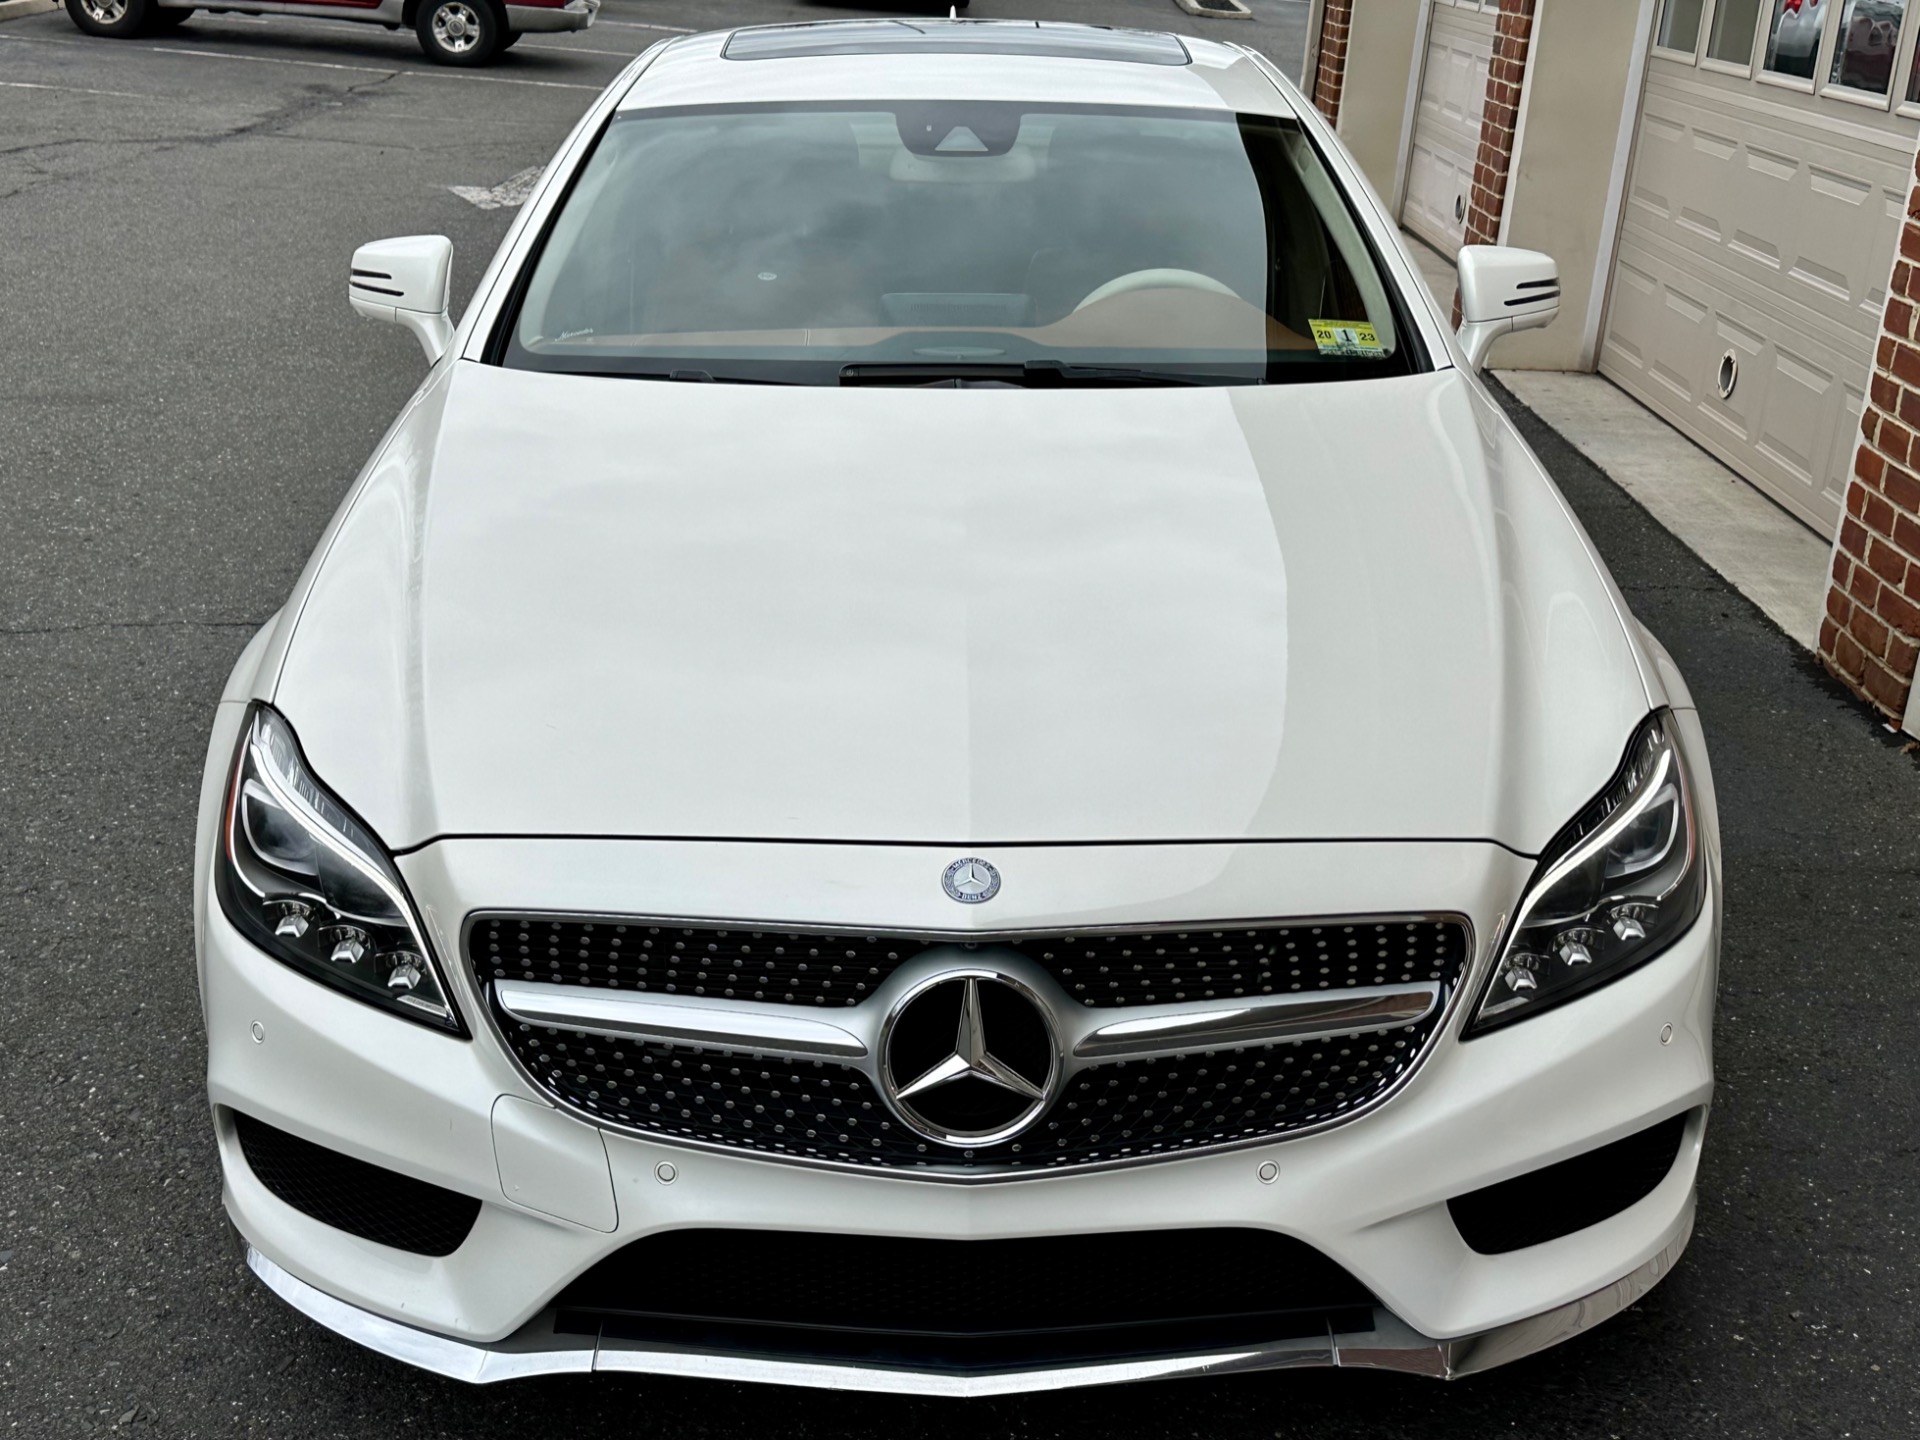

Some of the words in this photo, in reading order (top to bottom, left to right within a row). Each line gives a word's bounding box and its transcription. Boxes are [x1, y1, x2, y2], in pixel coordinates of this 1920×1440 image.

[1317, 330, 1332, 339] 20
[1342, 329, 1352, 342] 1
[1359, 332, 1375, 342] 23
